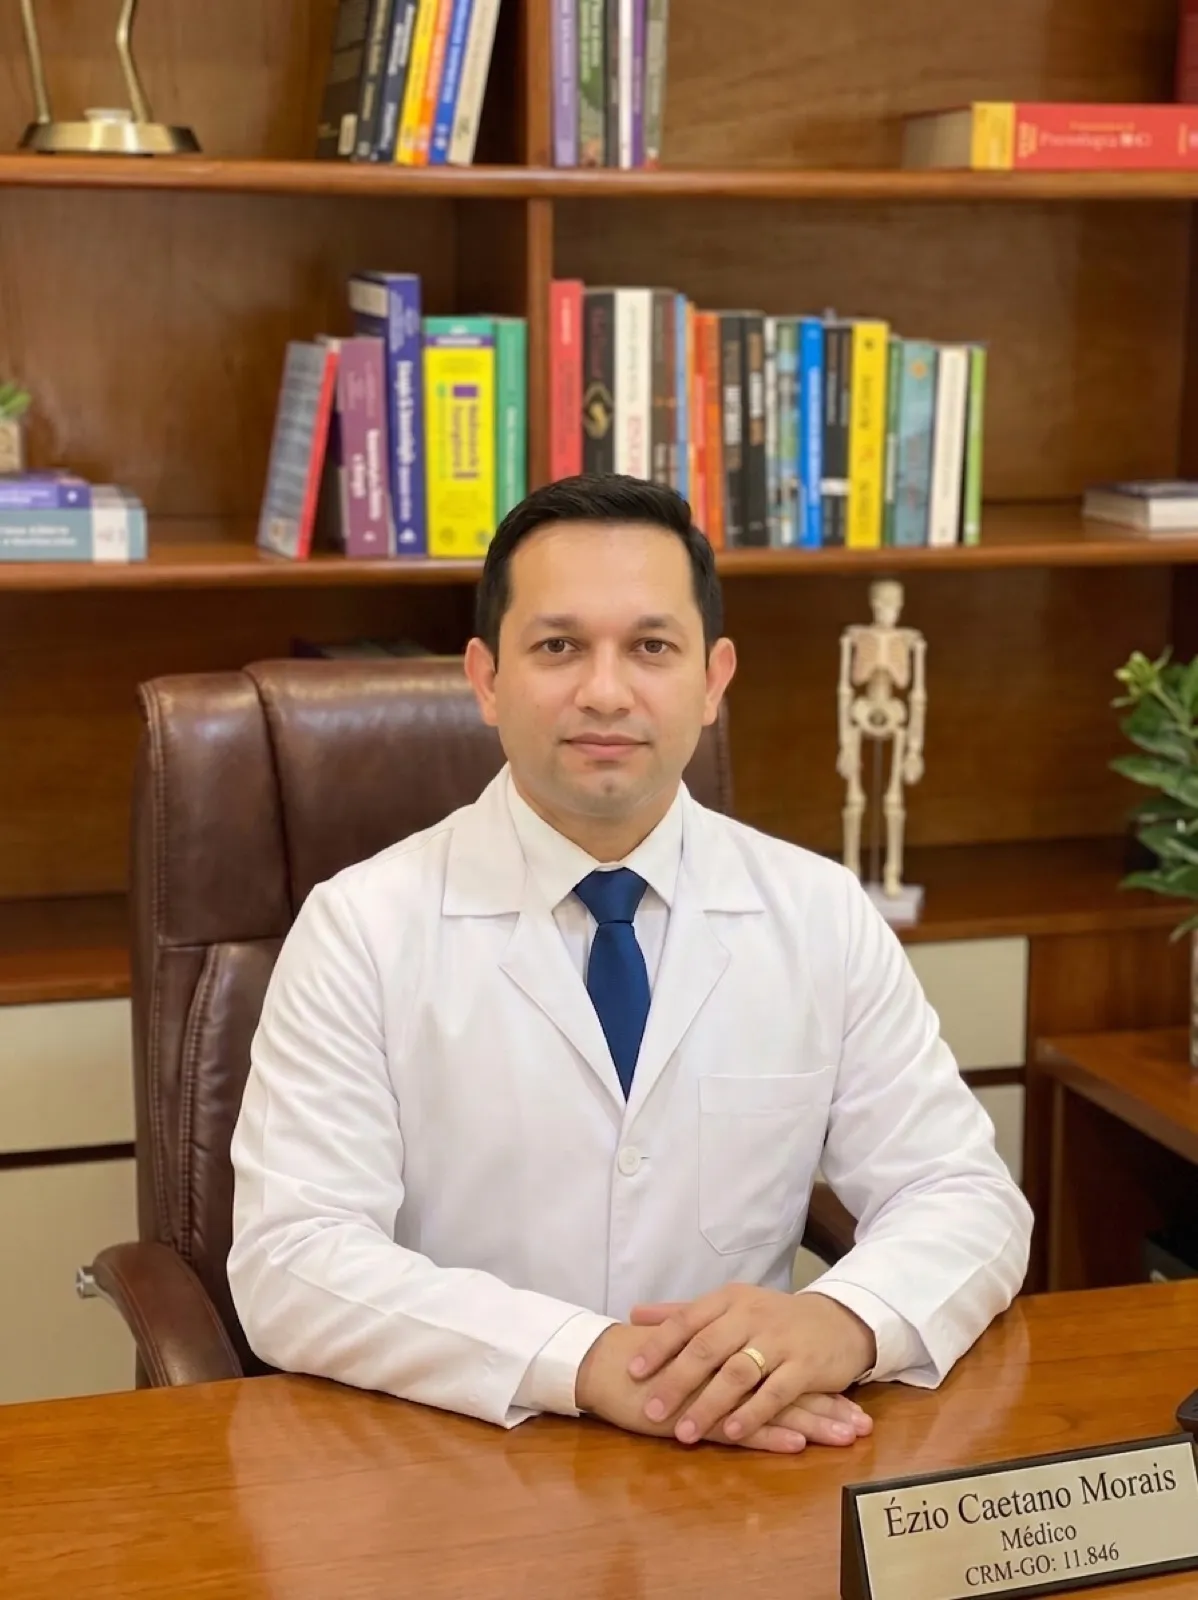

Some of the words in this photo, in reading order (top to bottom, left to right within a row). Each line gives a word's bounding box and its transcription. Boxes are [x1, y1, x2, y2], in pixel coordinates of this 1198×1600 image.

[884, 1497, 949, 1538] Ézio
[958, 1488, 1072, 1525] Caetano
[1078, 1462, 1177, 1505] Morais
[1000, 1522, 1077, 1551] Médico
[965, 1555, 1057, 1586] CRM-GO:
[1063, 1542, 1119, 1570] 11.846
